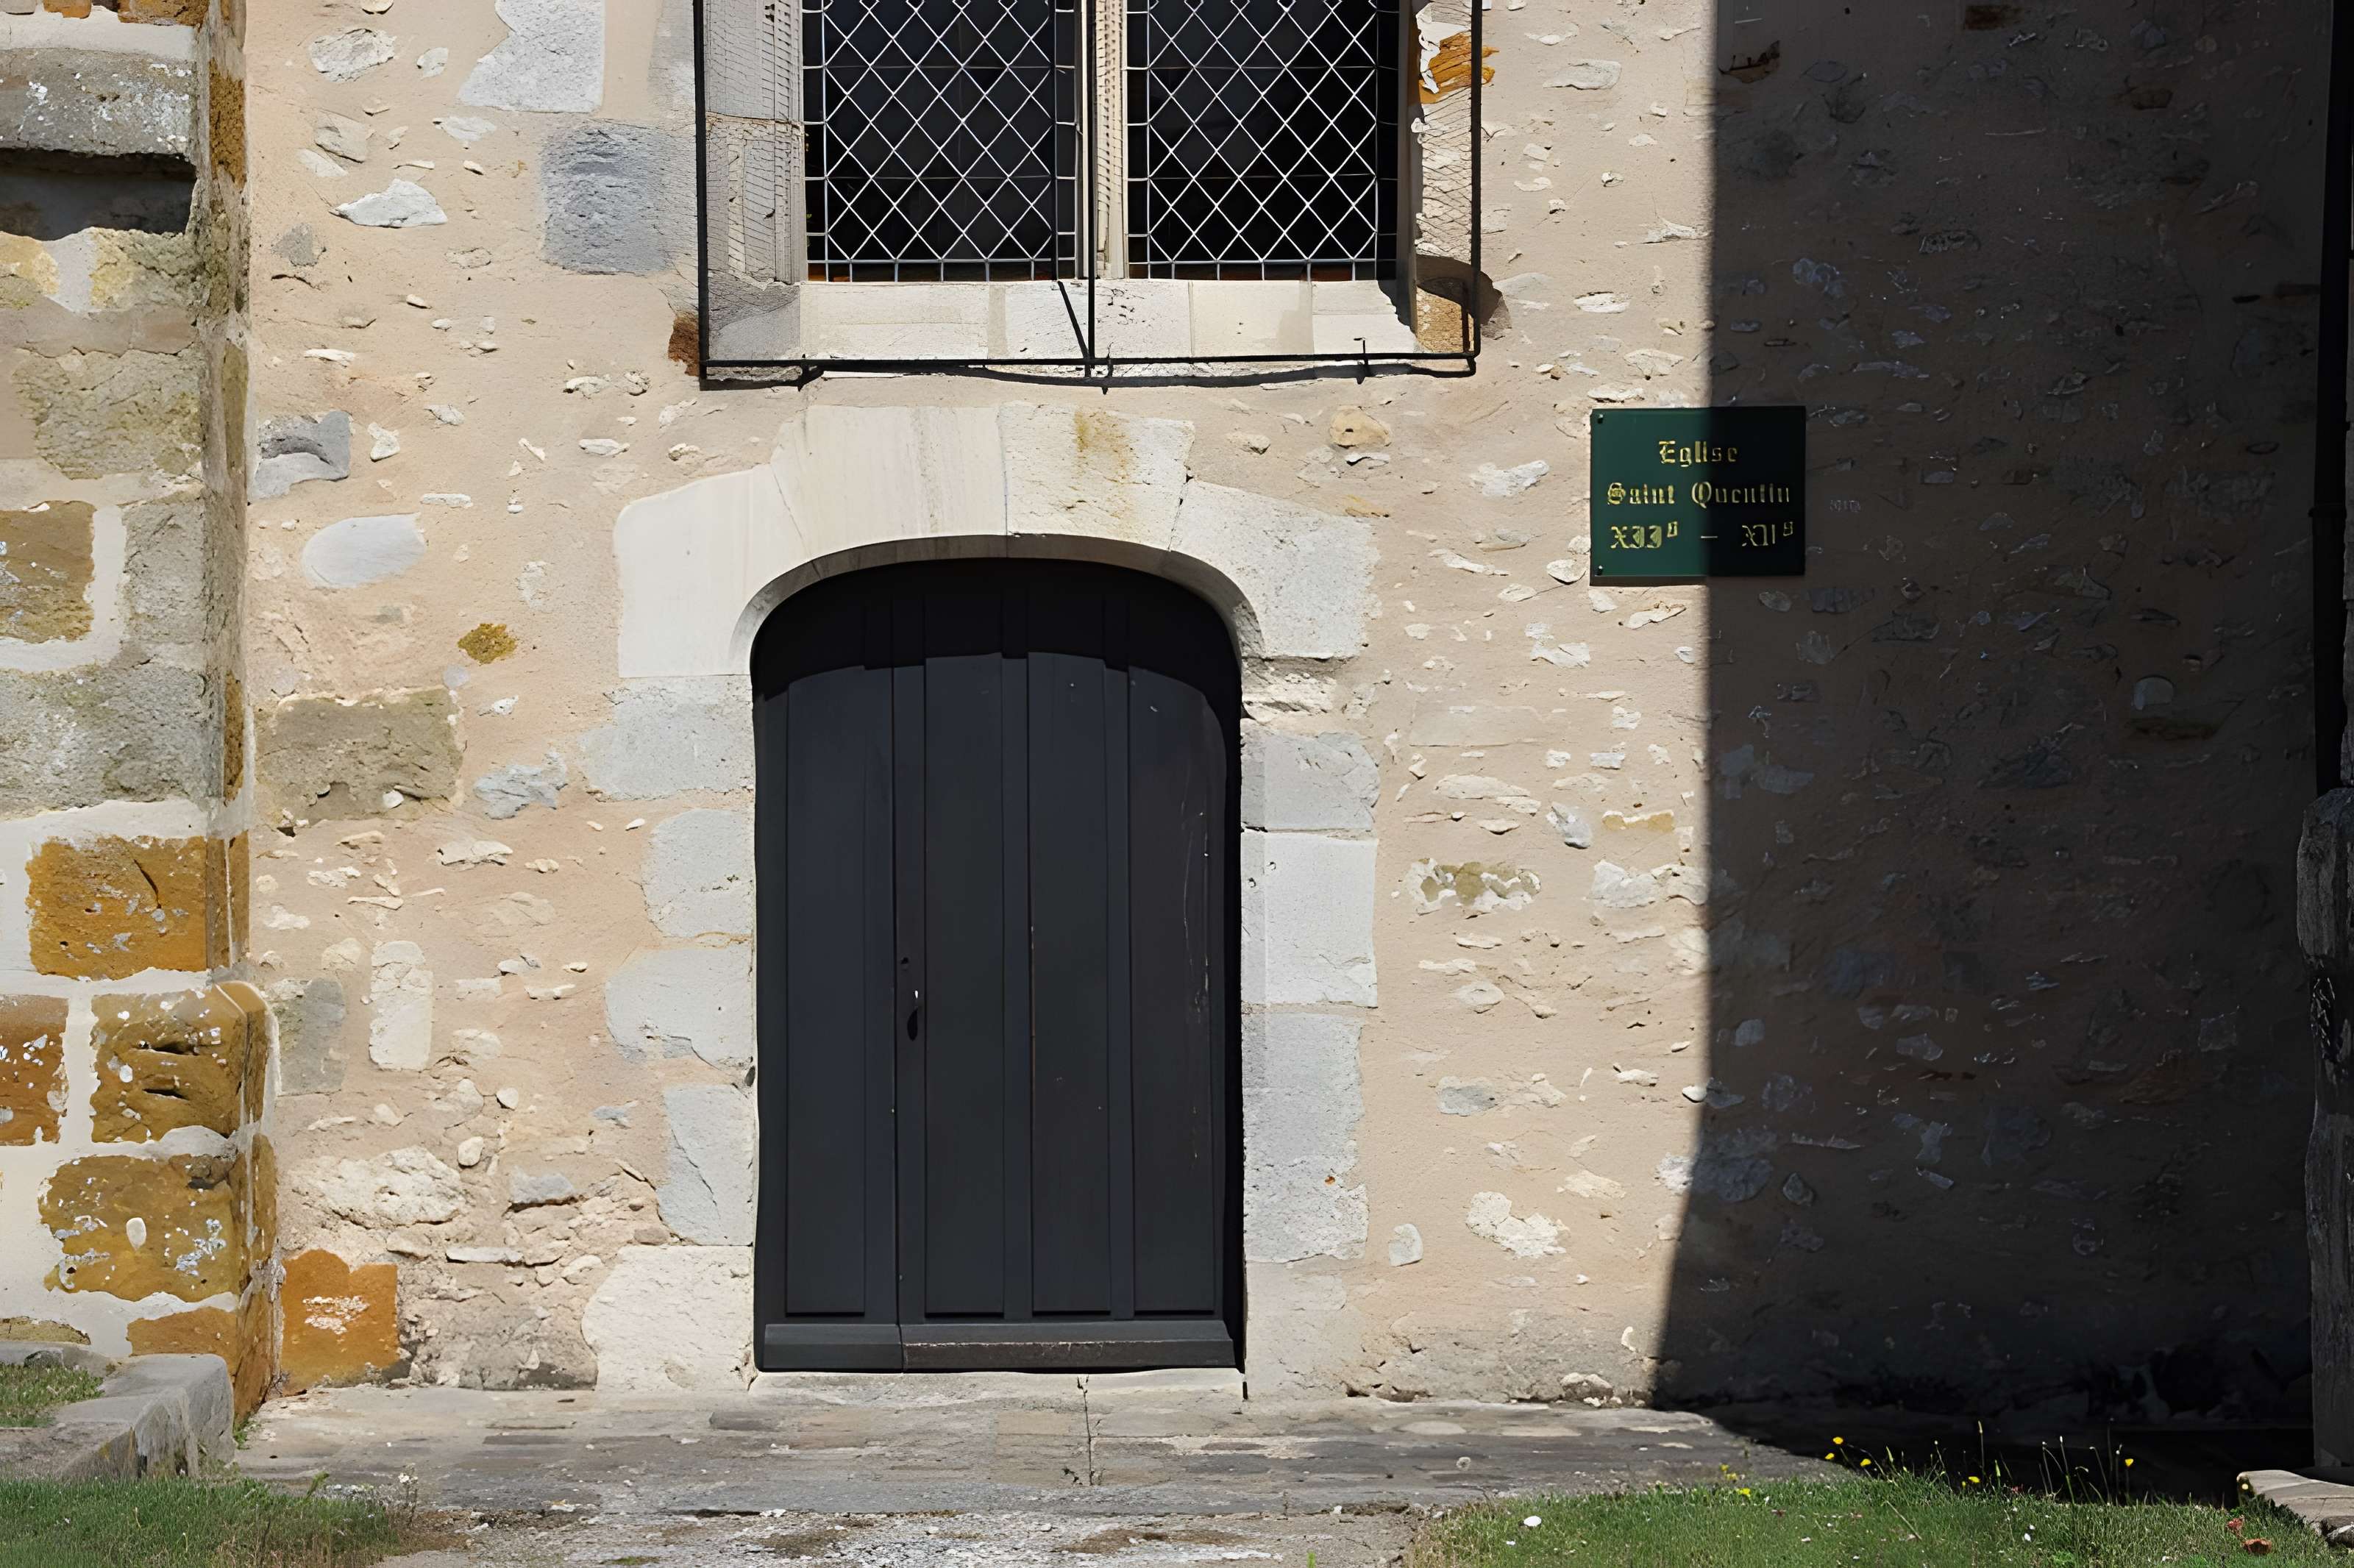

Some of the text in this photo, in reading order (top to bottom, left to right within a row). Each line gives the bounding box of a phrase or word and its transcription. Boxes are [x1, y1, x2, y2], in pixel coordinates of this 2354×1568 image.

[1658, 440, 1738, 468] Eglise
[1607, 481, 1791, 509] Saint Quentin
